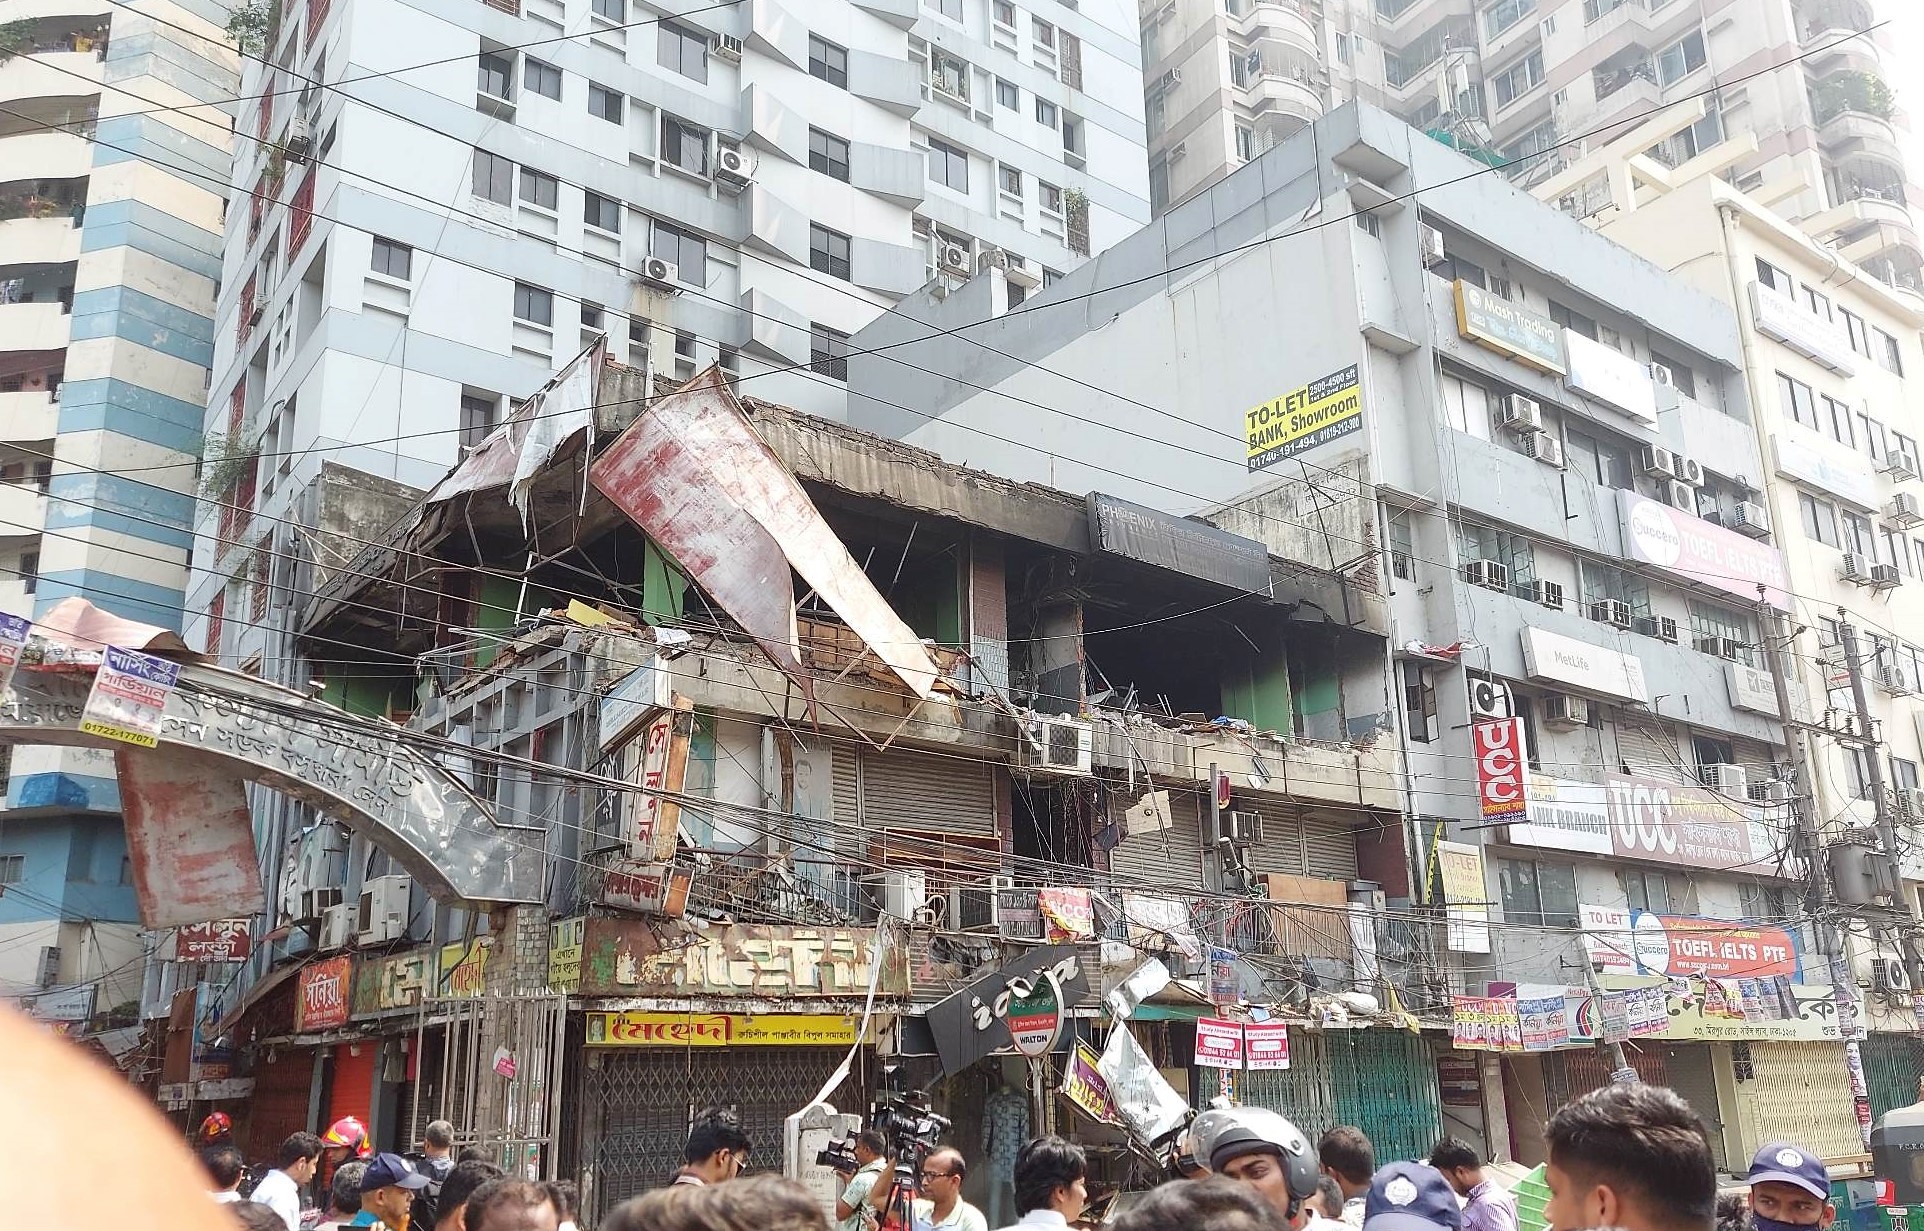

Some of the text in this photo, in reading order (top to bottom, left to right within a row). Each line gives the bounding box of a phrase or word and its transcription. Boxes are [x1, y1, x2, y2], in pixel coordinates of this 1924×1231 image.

[1484, 297, 1514, 321] Mash
[1515, 311, 1555, 343] Trading
[1309, 367, 1356, 397] 2500-4500 sft
[1327, 386, 1339, 396] 2nd
[1340, 379, 1357, 391] Floor
[1247, 389, 1307, 430] TO-LET
[1249, 394, 1358, 451] BANK, Showroom
[1632, 517, 1679, 547] Succero
[1554, 650, 1590, 672] MetLife
[84, 722, 155, 745] 01722-177071
[217, 726, 277, 758] সড়ক
[1478, 720, 1519, 803] UCC
[1556, 809, 1608, 836] BRANCH
[1609, 779, 1677, 855] UCC
[1588, 911, 1603, 924] TO
[1606, 912, 1624, 926] LET
[1636, 943, 1668, 955] Succero
[1720, 941, 1756, 961] IELTS
[1762, 945, 1787, 963] PTE
[611, 1015, 733, 1041] মেহেদী
[737, 1029, 769, 1041] রুচিশীল
[803, 1028, 824, 1042] বিপুল
[825, 1029, 852, 1041] সমাহার
[1019, 1034, 1049, 1045] WALTON
